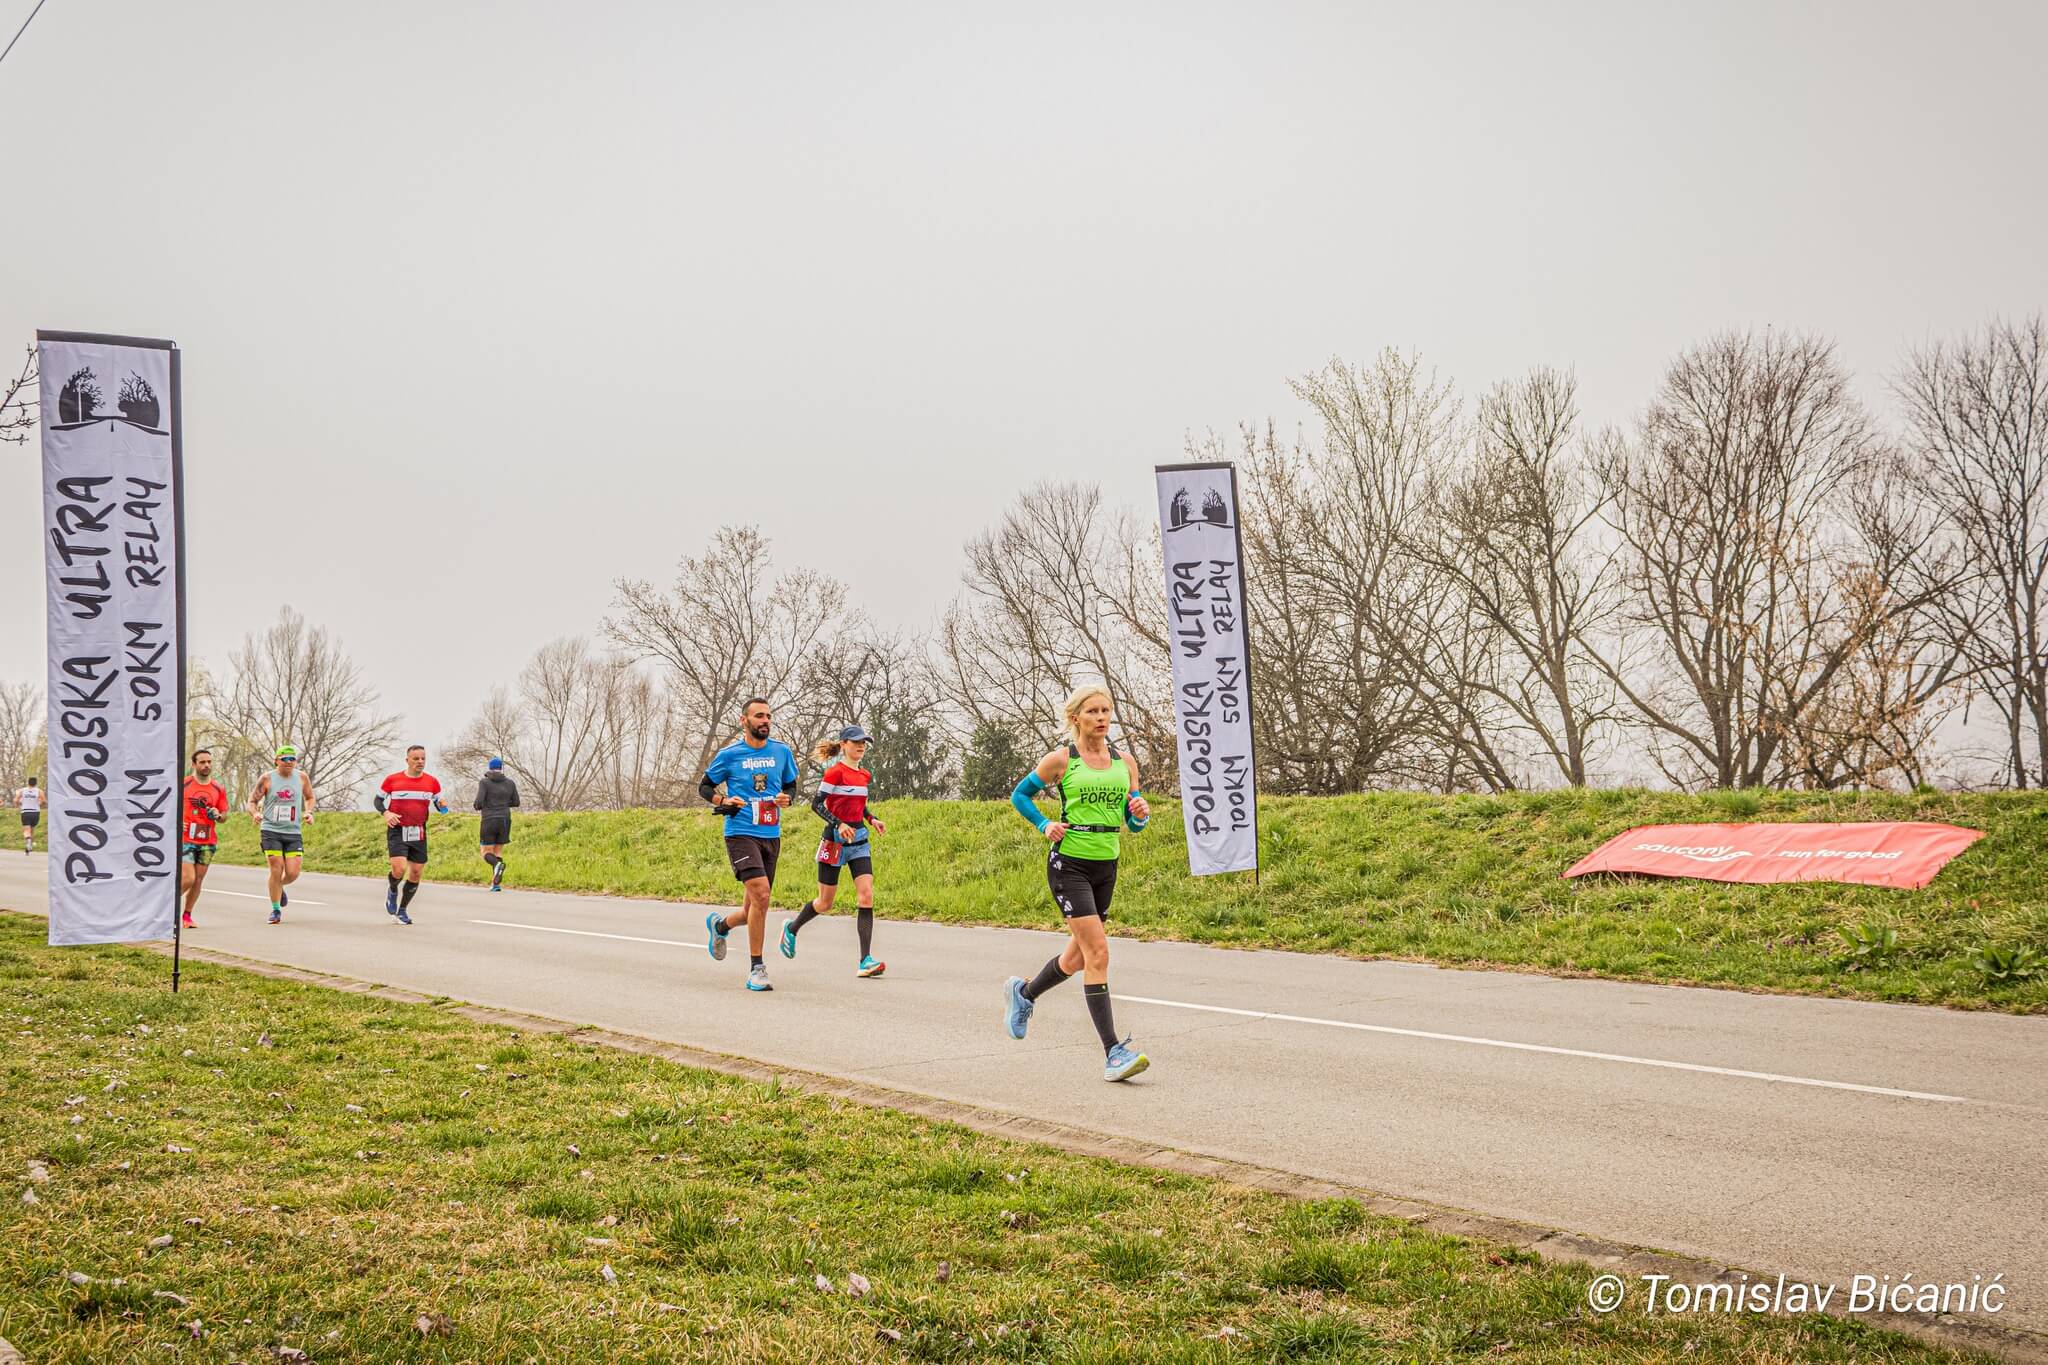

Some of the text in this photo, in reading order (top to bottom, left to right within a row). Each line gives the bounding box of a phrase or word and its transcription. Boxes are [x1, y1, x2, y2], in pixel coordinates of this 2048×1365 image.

[50, 476, 119, 883] POLOJSKA ULTRA
[123, 477, 172, 882] 100KM 50KM RELAY
[1170, 561, 1220, 836] POLOJSKA ULTRA
[1209, 560, 1249, 832] 100KM 50KM RELAY
[763, 813, 772, 822] 16
[1632, 843, 1734, 857] saucony
[1778, 849, 1812, 859] run
